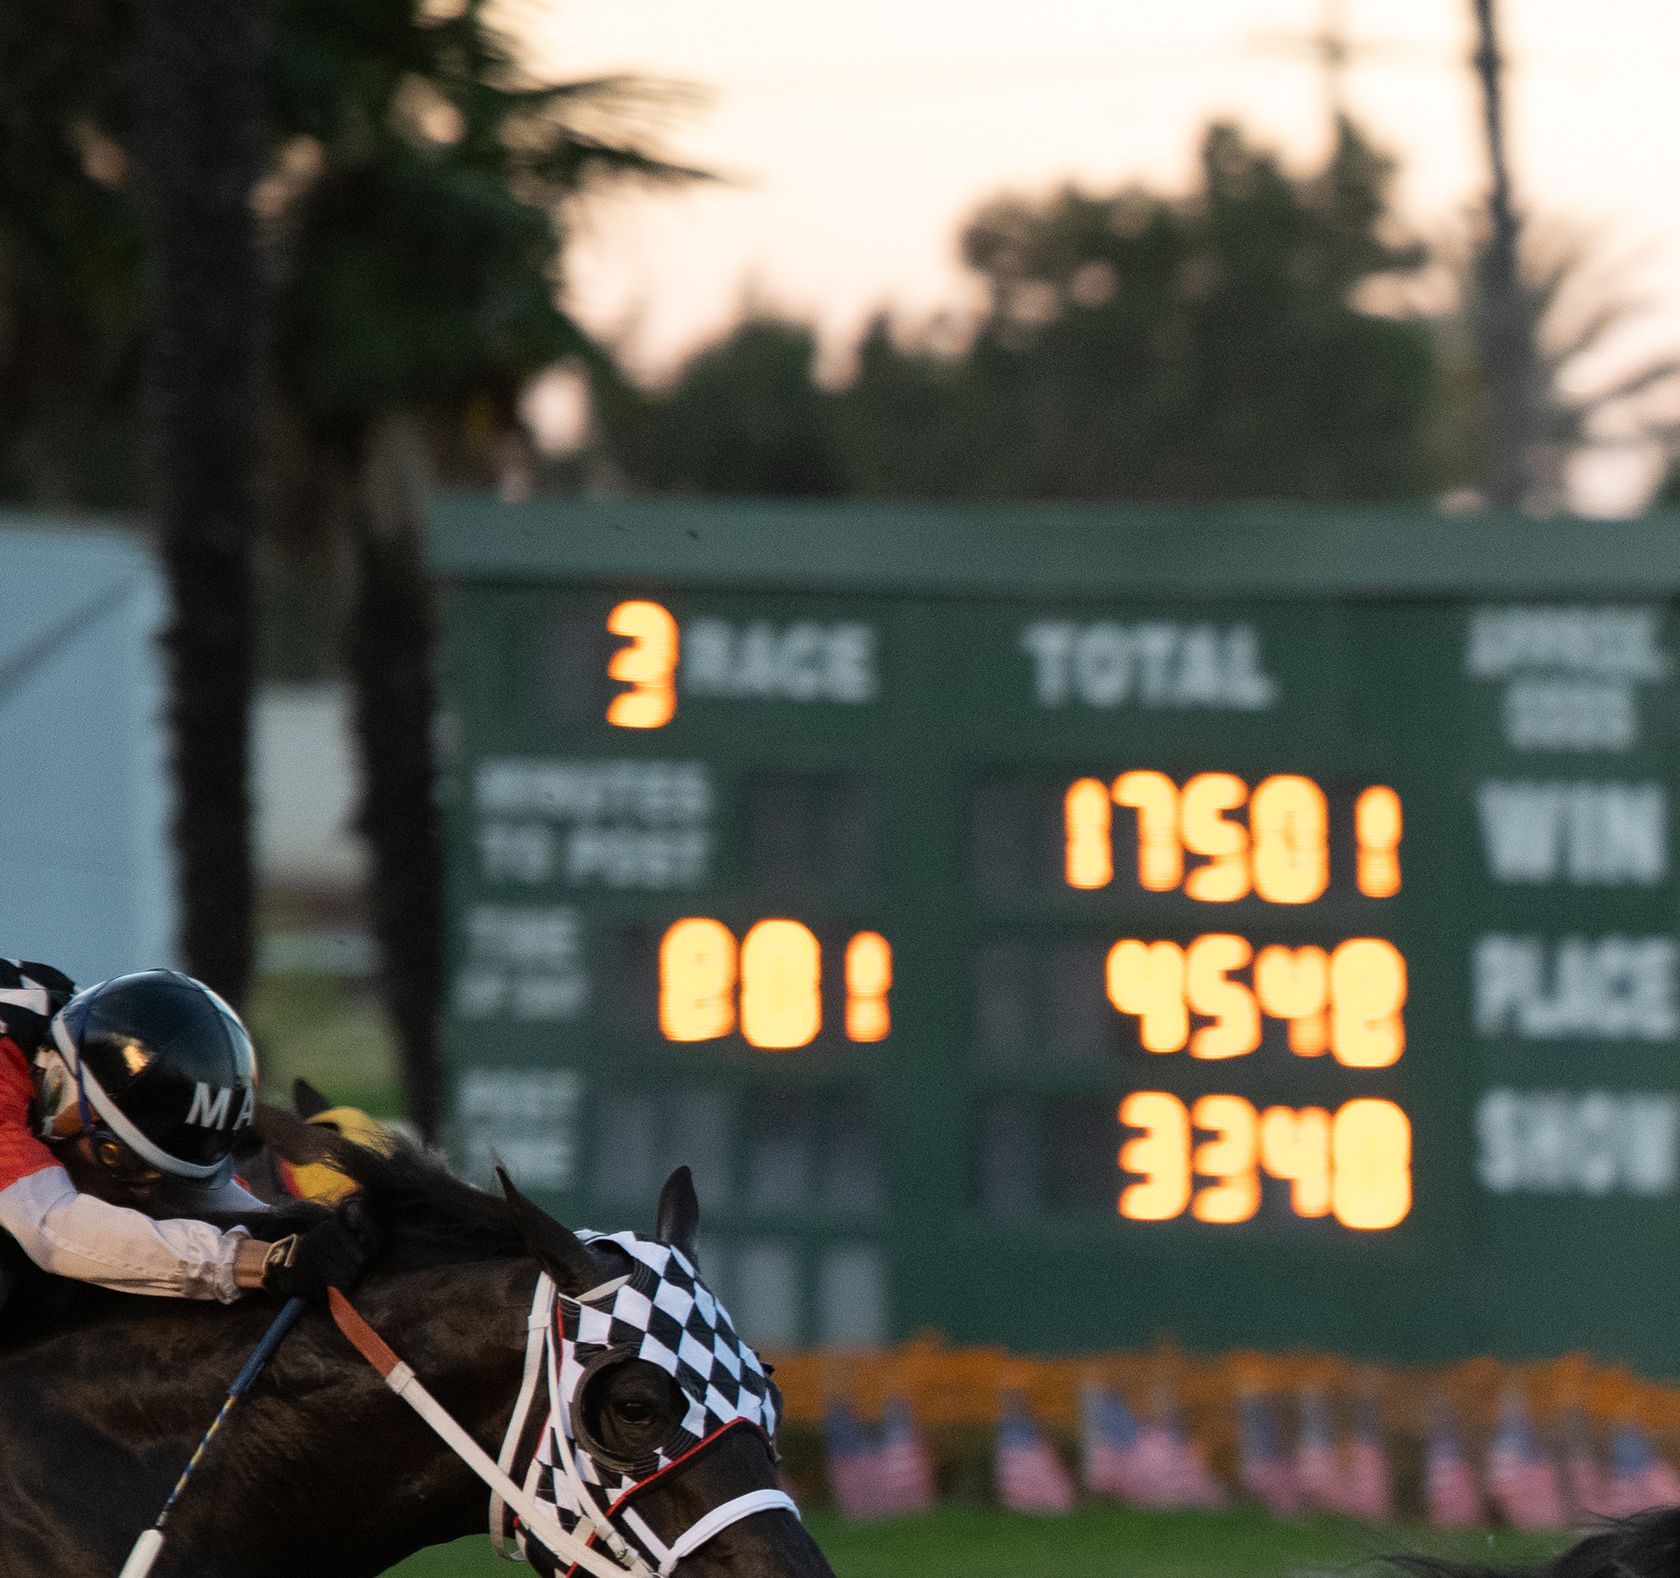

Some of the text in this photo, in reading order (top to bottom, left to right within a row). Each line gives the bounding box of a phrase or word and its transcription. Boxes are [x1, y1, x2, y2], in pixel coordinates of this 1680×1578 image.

[607, 600, 875, 730] 3 RACE
[1022, 622, 1275, 708] TOTAL
[1480, 780, 1668, 885] WIN
